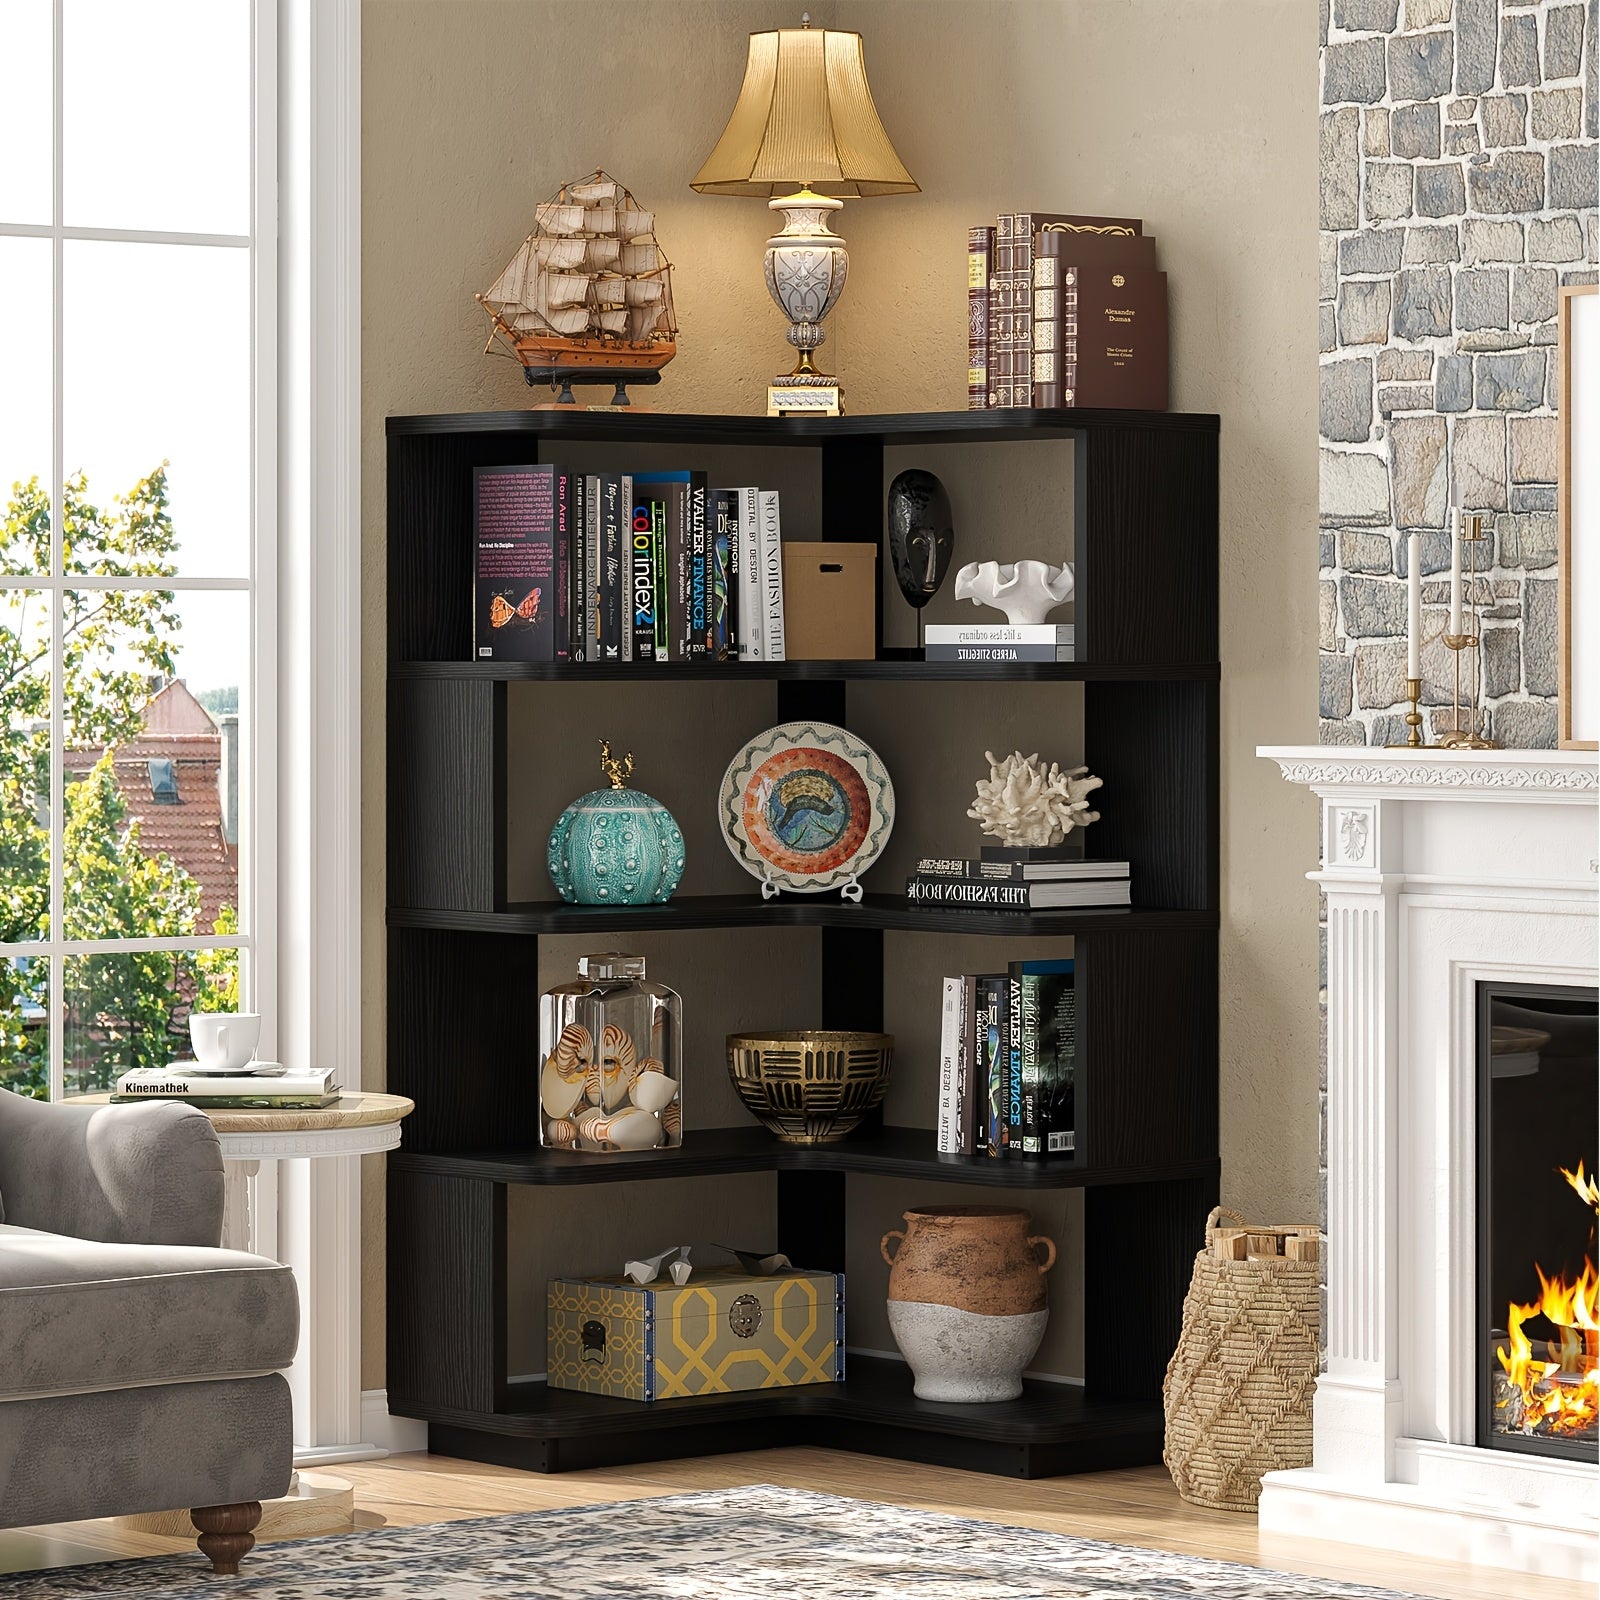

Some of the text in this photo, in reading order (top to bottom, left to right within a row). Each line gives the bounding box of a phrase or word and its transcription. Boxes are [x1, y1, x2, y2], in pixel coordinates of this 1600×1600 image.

[559, 476, 567, 500] Ron
[559, 503, 567, 532] Arad
[747, 488, 758, 584] DIGITAL BY DESIGN
[587, 487, 596, 635] INNENARCHITEKTUR
[693, 487, 704, 630] WALTER FINANCE
[731, 520, 739, 574] INTERIORS
[764, 495, 782, 660] THE FASHION BOOK
[730, 632, 735, 644] 1
[125, 1083, 189, 1094] Kinemathek
